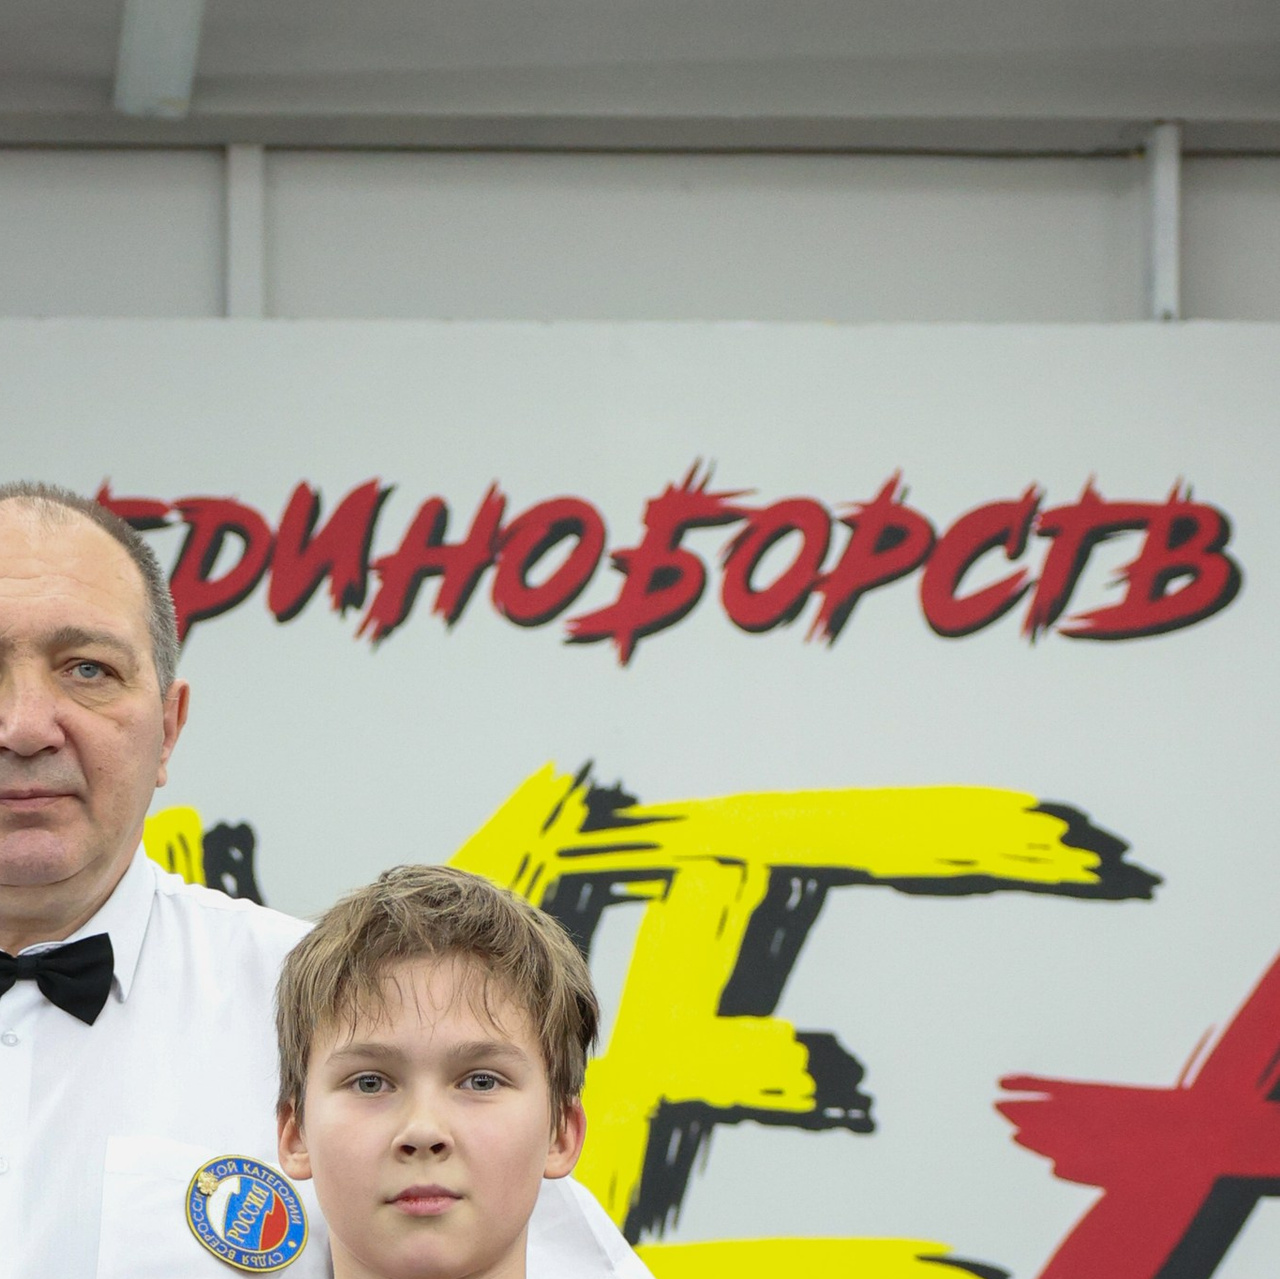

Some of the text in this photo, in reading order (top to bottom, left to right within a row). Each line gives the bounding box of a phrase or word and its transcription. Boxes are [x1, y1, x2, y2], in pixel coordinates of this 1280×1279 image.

[227, 1183, 269, 1243] РОССИЯ
[243, 1164, 301, 1225] КАТЕГОРИИ
[242, 1252, 284, 1267] СУДЬЯ
